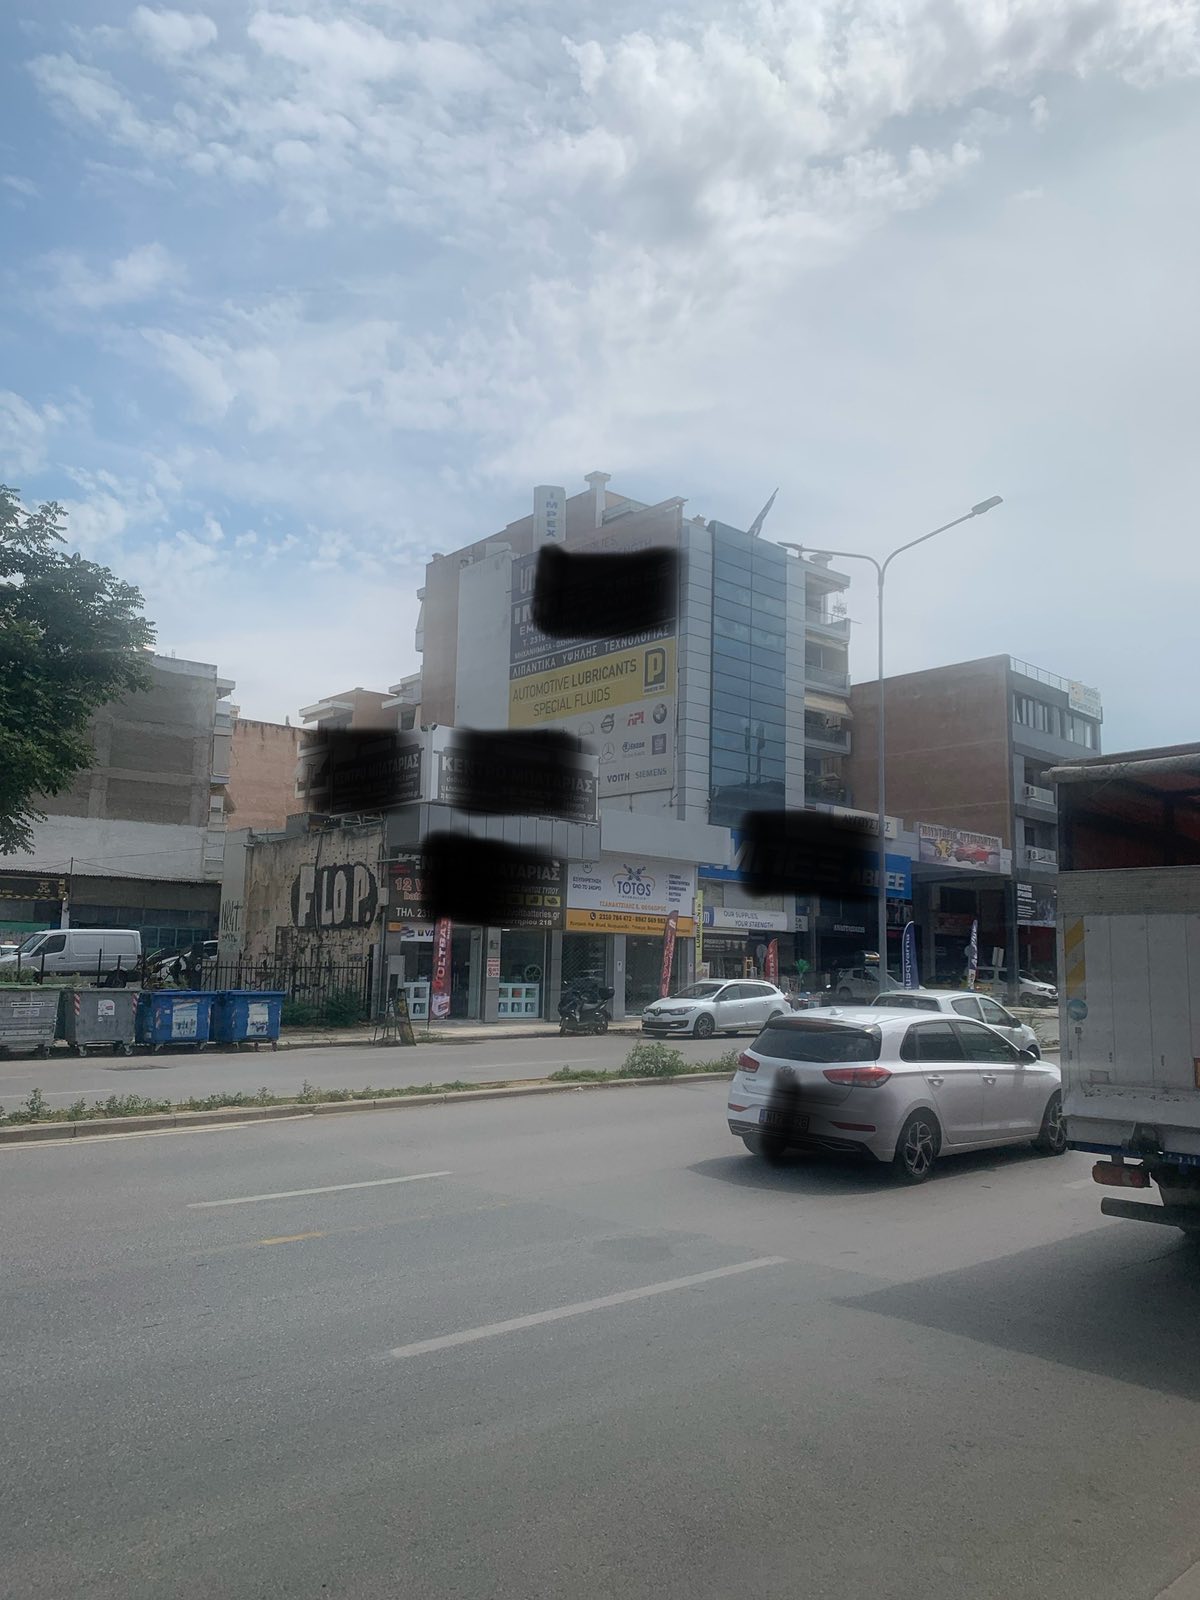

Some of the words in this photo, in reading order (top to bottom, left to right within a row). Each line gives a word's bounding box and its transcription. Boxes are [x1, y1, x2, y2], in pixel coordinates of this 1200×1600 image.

[512, 657, 556, 677] ΛΙΠΑΝΤΙΚΑ
[562, 644, 597, 664] ΥΨΗΛΗΣ
[604, 624, 669, 651] ΤΕΧΝΟΛΟΓΙΑΣ
[512, 676, 570, 702] AUTOMOTIVE
[571, 658, 637, 687] LUBRICANTS
[533, 696, 572, 717] SPECIAL
[574, 687, 611, 708] FLUIDS
[606, 772, 630, 784] VOITH
[635, 769, 667, 780] SIEMENS
[617, 881, 652, 897] TOTOS
[395, 907, 416, 919] ΤΗΛ.
[723, 910, 734, 918] OUR
[735, 920, 748, 928] YOUR
[748, 921, 774, 929] STRENGTH
